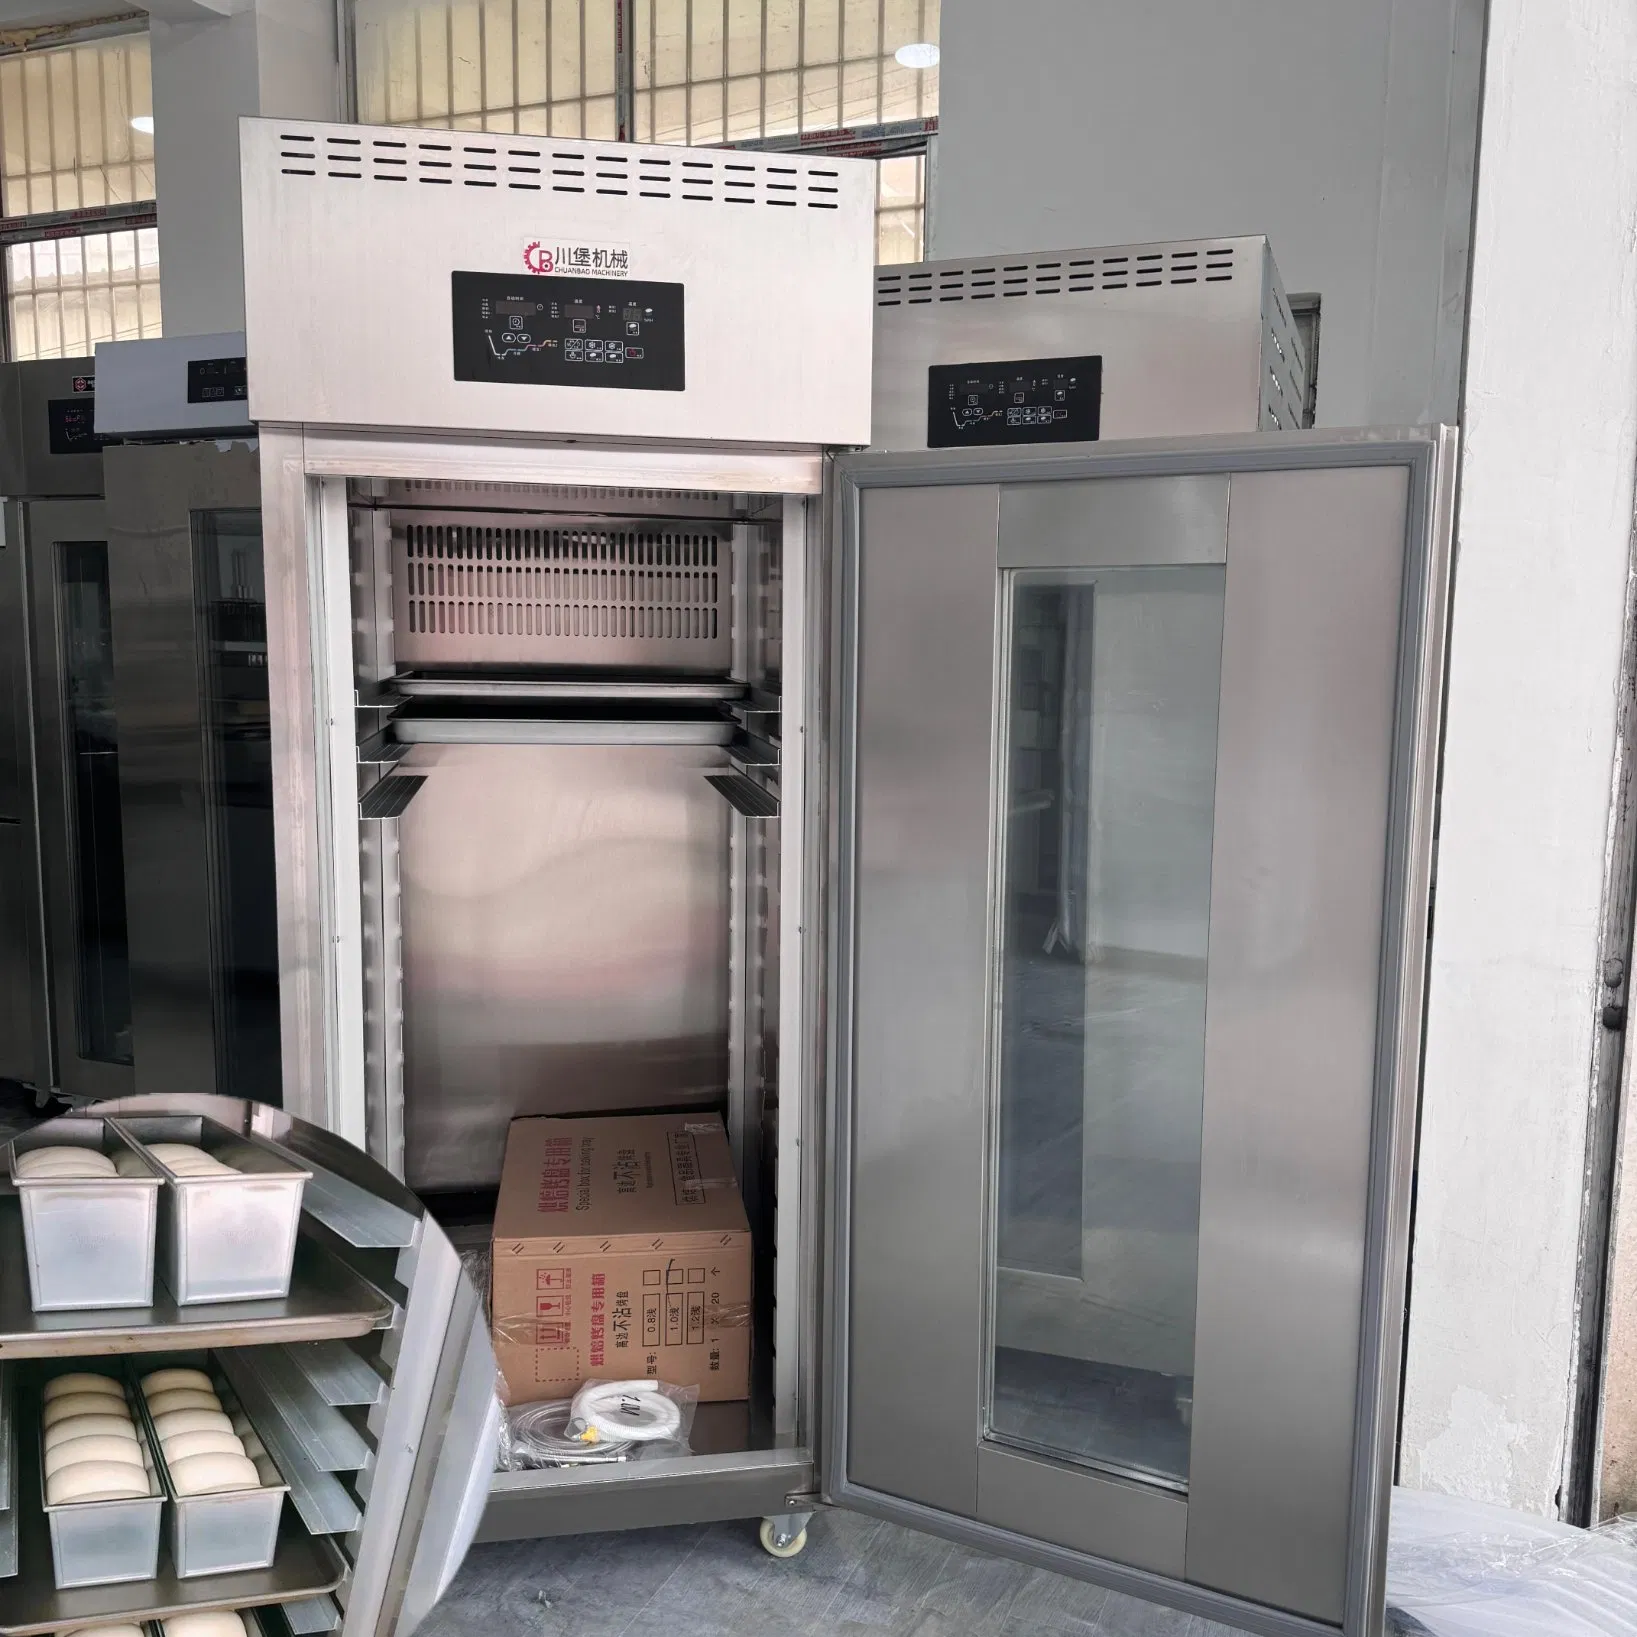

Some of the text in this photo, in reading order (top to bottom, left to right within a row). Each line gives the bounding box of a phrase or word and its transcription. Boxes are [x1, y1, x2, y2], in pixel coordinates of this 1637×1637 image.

[555, 247, 628, 269] 川堡机械
[555, 266, 628, 277] CHUANBAO MACHINERY
[537, 1137, 572, 1213] 烘焙烤盘专用箱
[575, 1188, 592, 1212] Special
[711, 1292, 720, 1304] 20
[589, 1273, 606, 1367] 烘焙烤盘专用箱
[611, 1291, 632, 1348] 高边不沾烤盘
